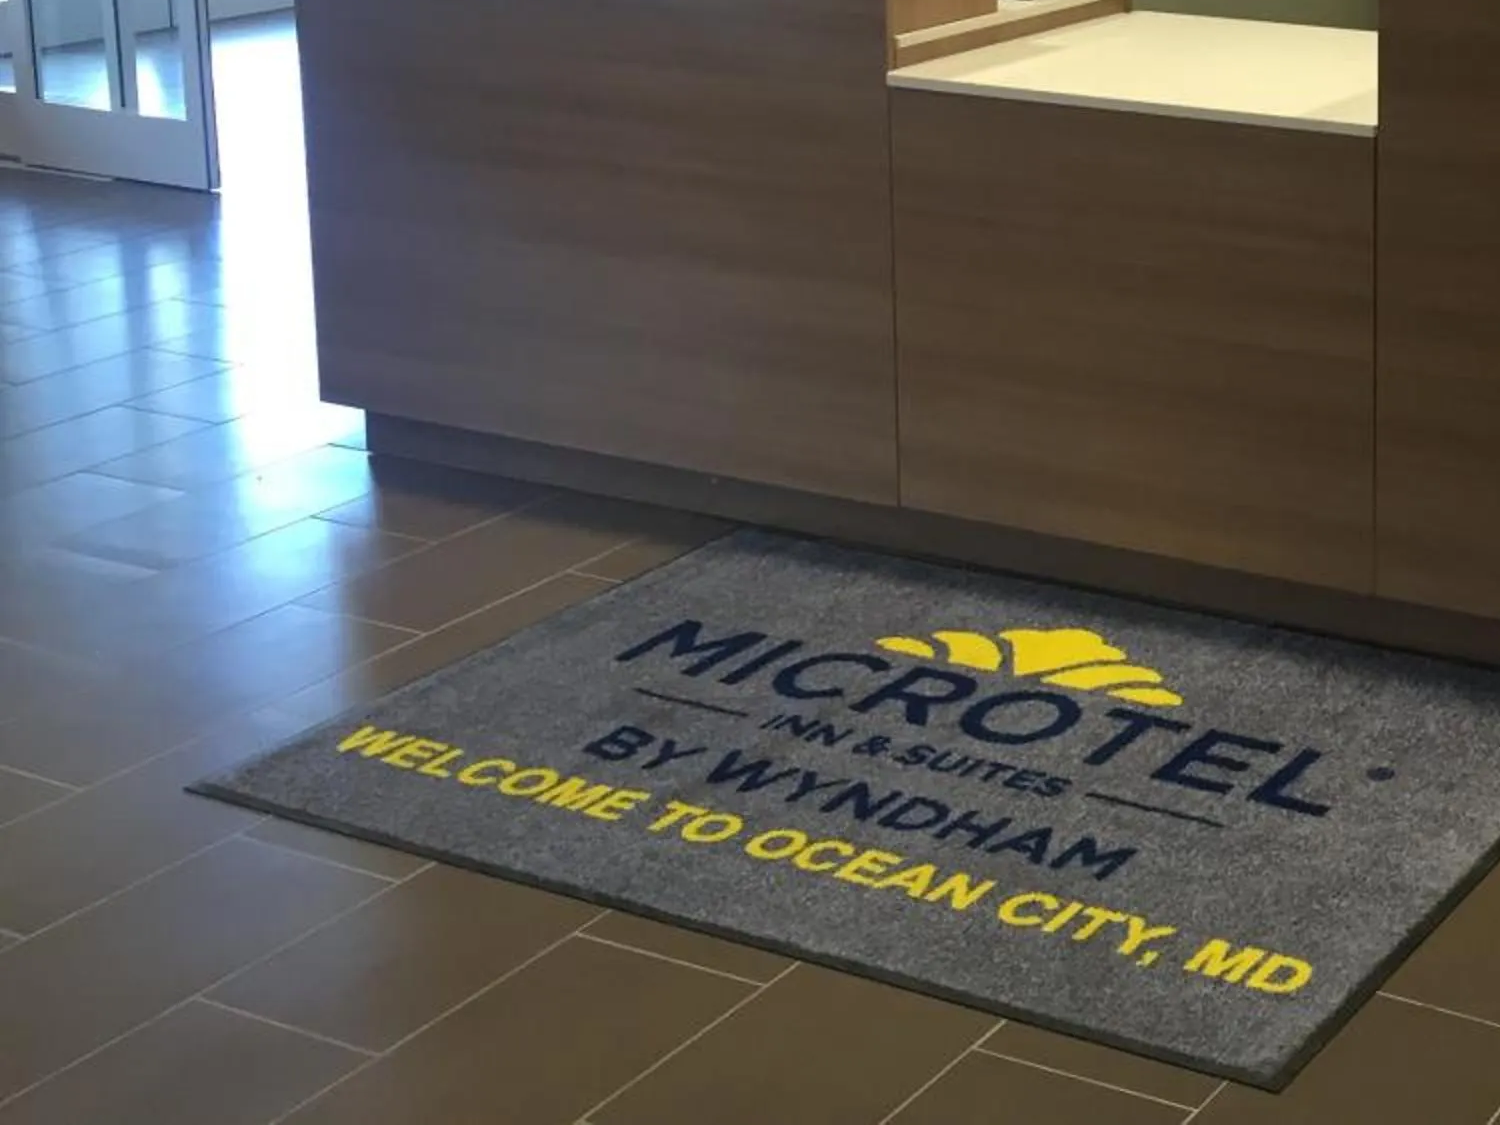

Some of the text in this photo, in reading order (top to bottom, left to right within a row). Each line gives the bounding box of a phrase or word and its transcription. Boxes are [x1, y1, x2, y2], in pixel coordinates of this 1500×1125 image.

[583, 725, 1138, 881] BY WYNDHAM
[616, 619, 1331, 817] MICROTEL
[760, 714, 1073, 797] INN & SUITES
[335, 724, 1313, 995] WELCOME TO OCEAN CITY, MD
